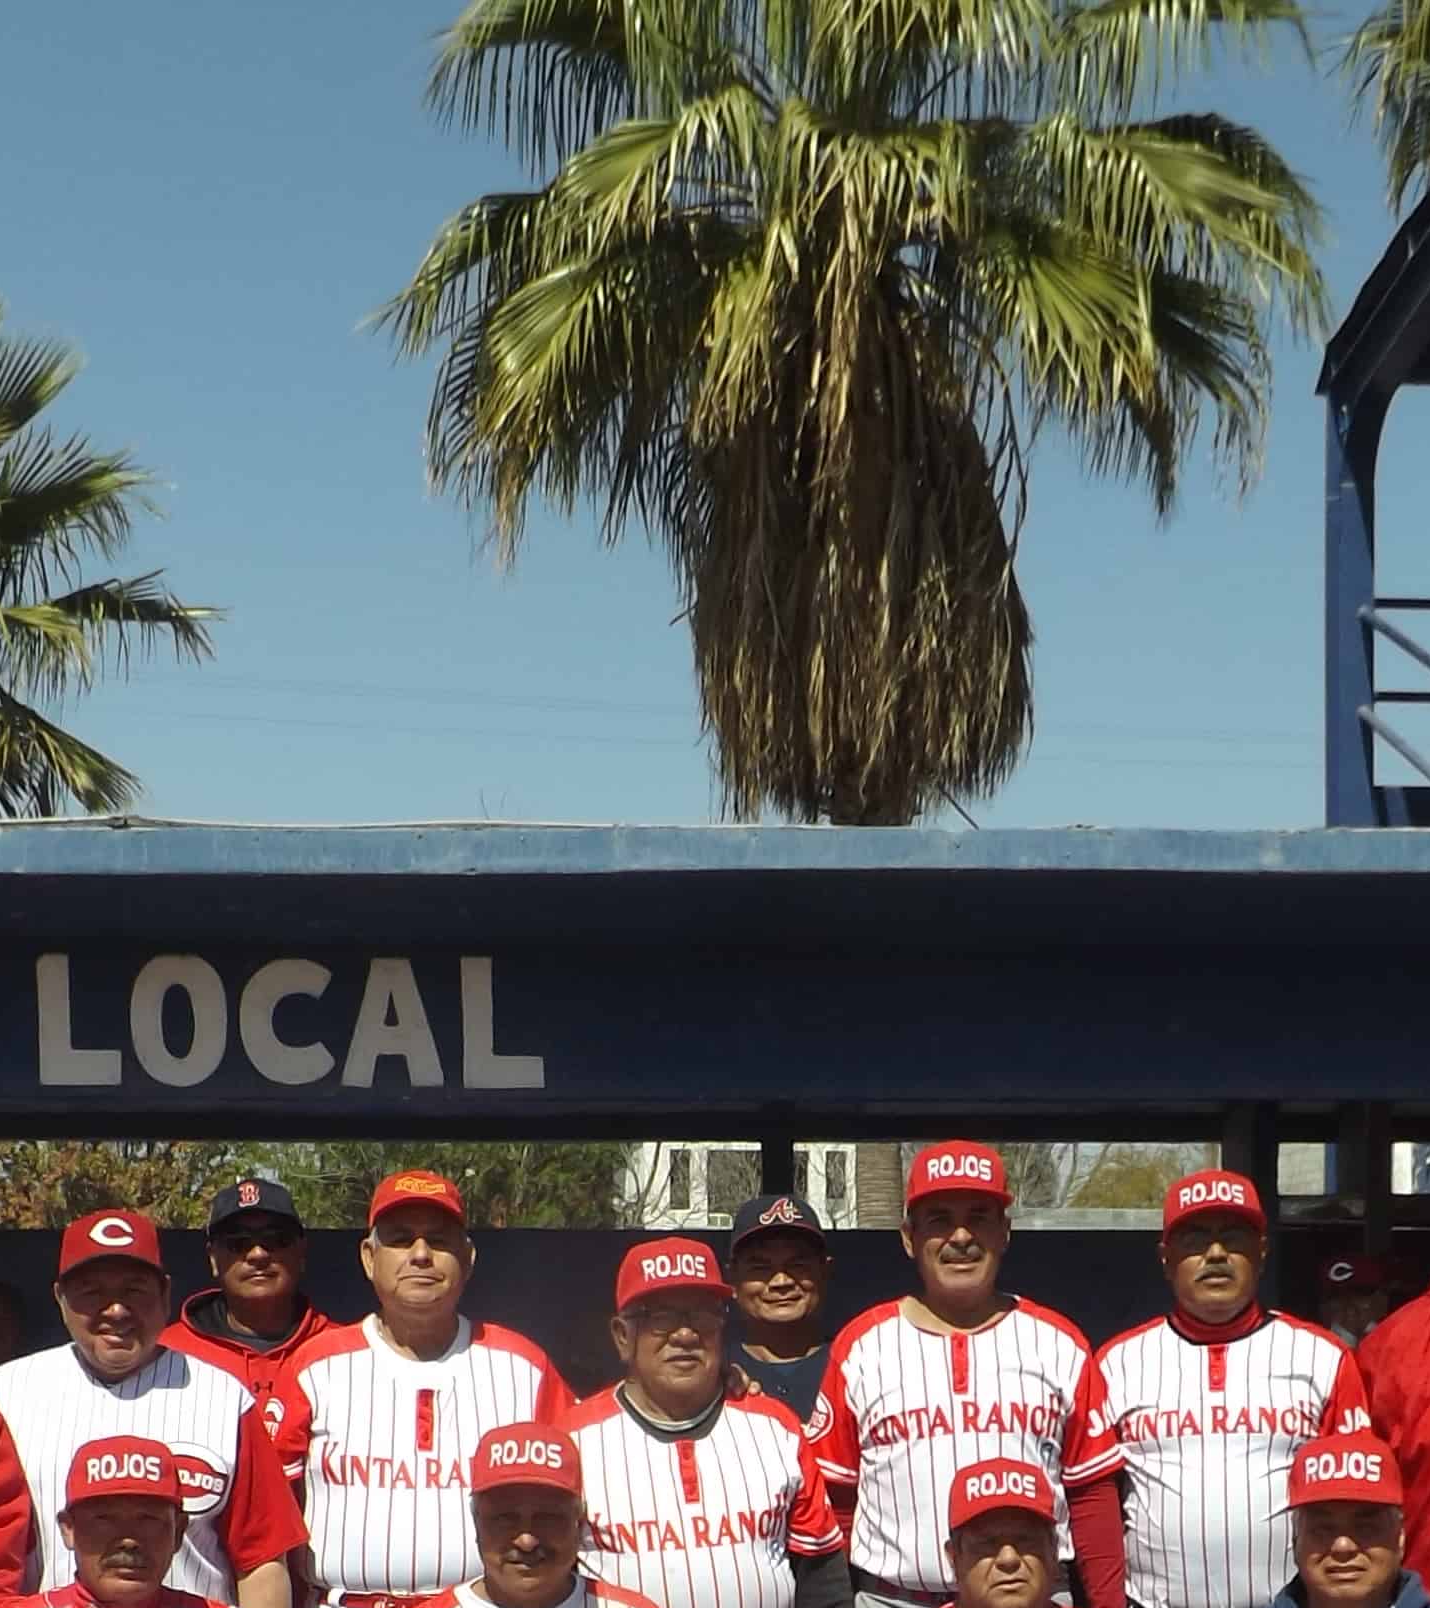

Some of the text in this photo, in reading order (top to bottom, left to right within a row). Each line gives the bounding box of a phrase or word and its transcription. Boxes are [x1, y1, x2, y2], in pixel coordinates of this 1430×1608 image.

[36, 953, 545, 1089] LOCAL
[926, 1154, 993, 1183] ROJOS
[1178, 1180, 1246, 1209] ROJOS
[89, 1216, 134, 1247] C
[641, 1252, 708, 1282] ROJOS
[86, 1453, 162, 1484] ROJOS
[321, 1441, 415, 1489] KINTA
[488, 1439, 563, 1470] ROJOS
[1304, 1451, 1383, 1485] ROJOS
[178, 1469, 225, 1493] OJOS
[965, 1471, 1036, 1502] ROJOS
